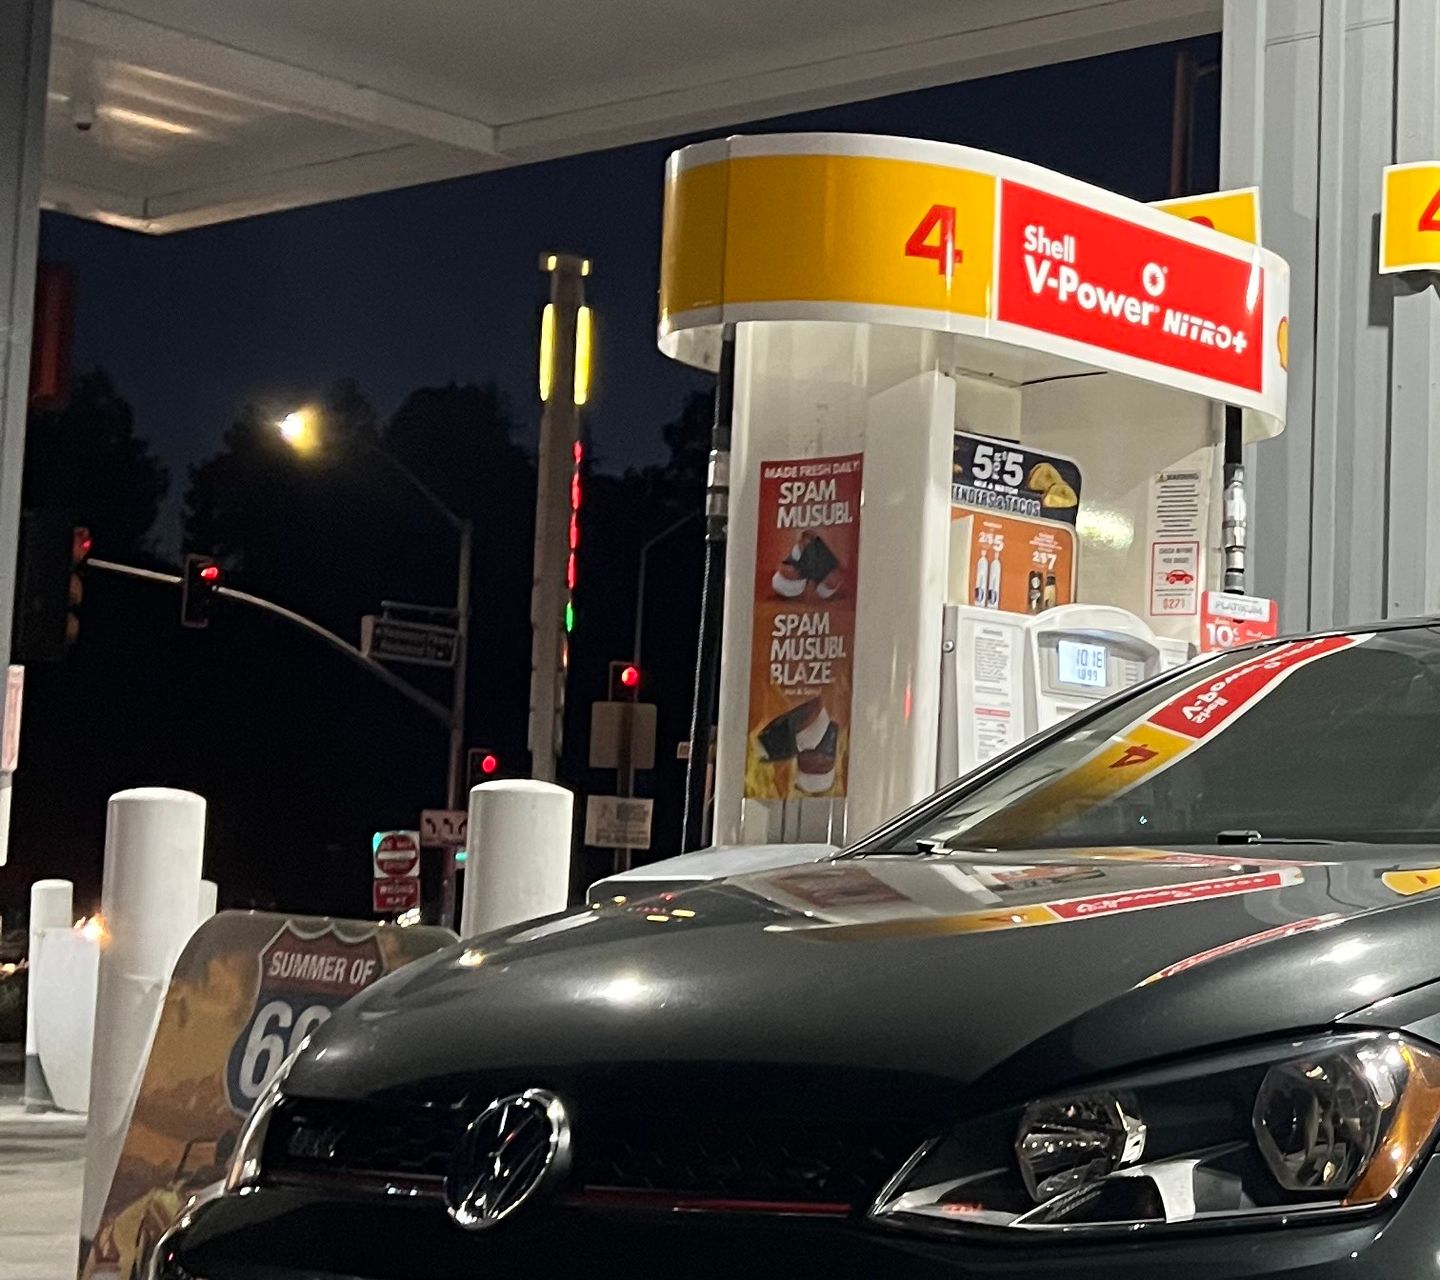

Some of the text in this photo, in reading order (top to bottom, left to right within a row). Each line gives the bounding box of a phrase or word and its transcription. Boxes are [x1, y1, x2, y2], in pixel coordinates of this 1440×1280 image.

[905, 204, 963, 275] 4
[1023, 225, 1075, 263] Shell
[1024, 255, 1155, 326] V-Power
[764, 465, 798, 479] MADE
[800, 462, 831, 477] FRESH
[972, 444, 994, 480] 5
[778, 479, 836, 504] SPAM
[1005, 495, 1041, 517] TACOS
[772, 612, 830, 637] SPAM
[770, 662, 832, 685] BLAZE
[269, 951, 375, 985] SUMMER OF
